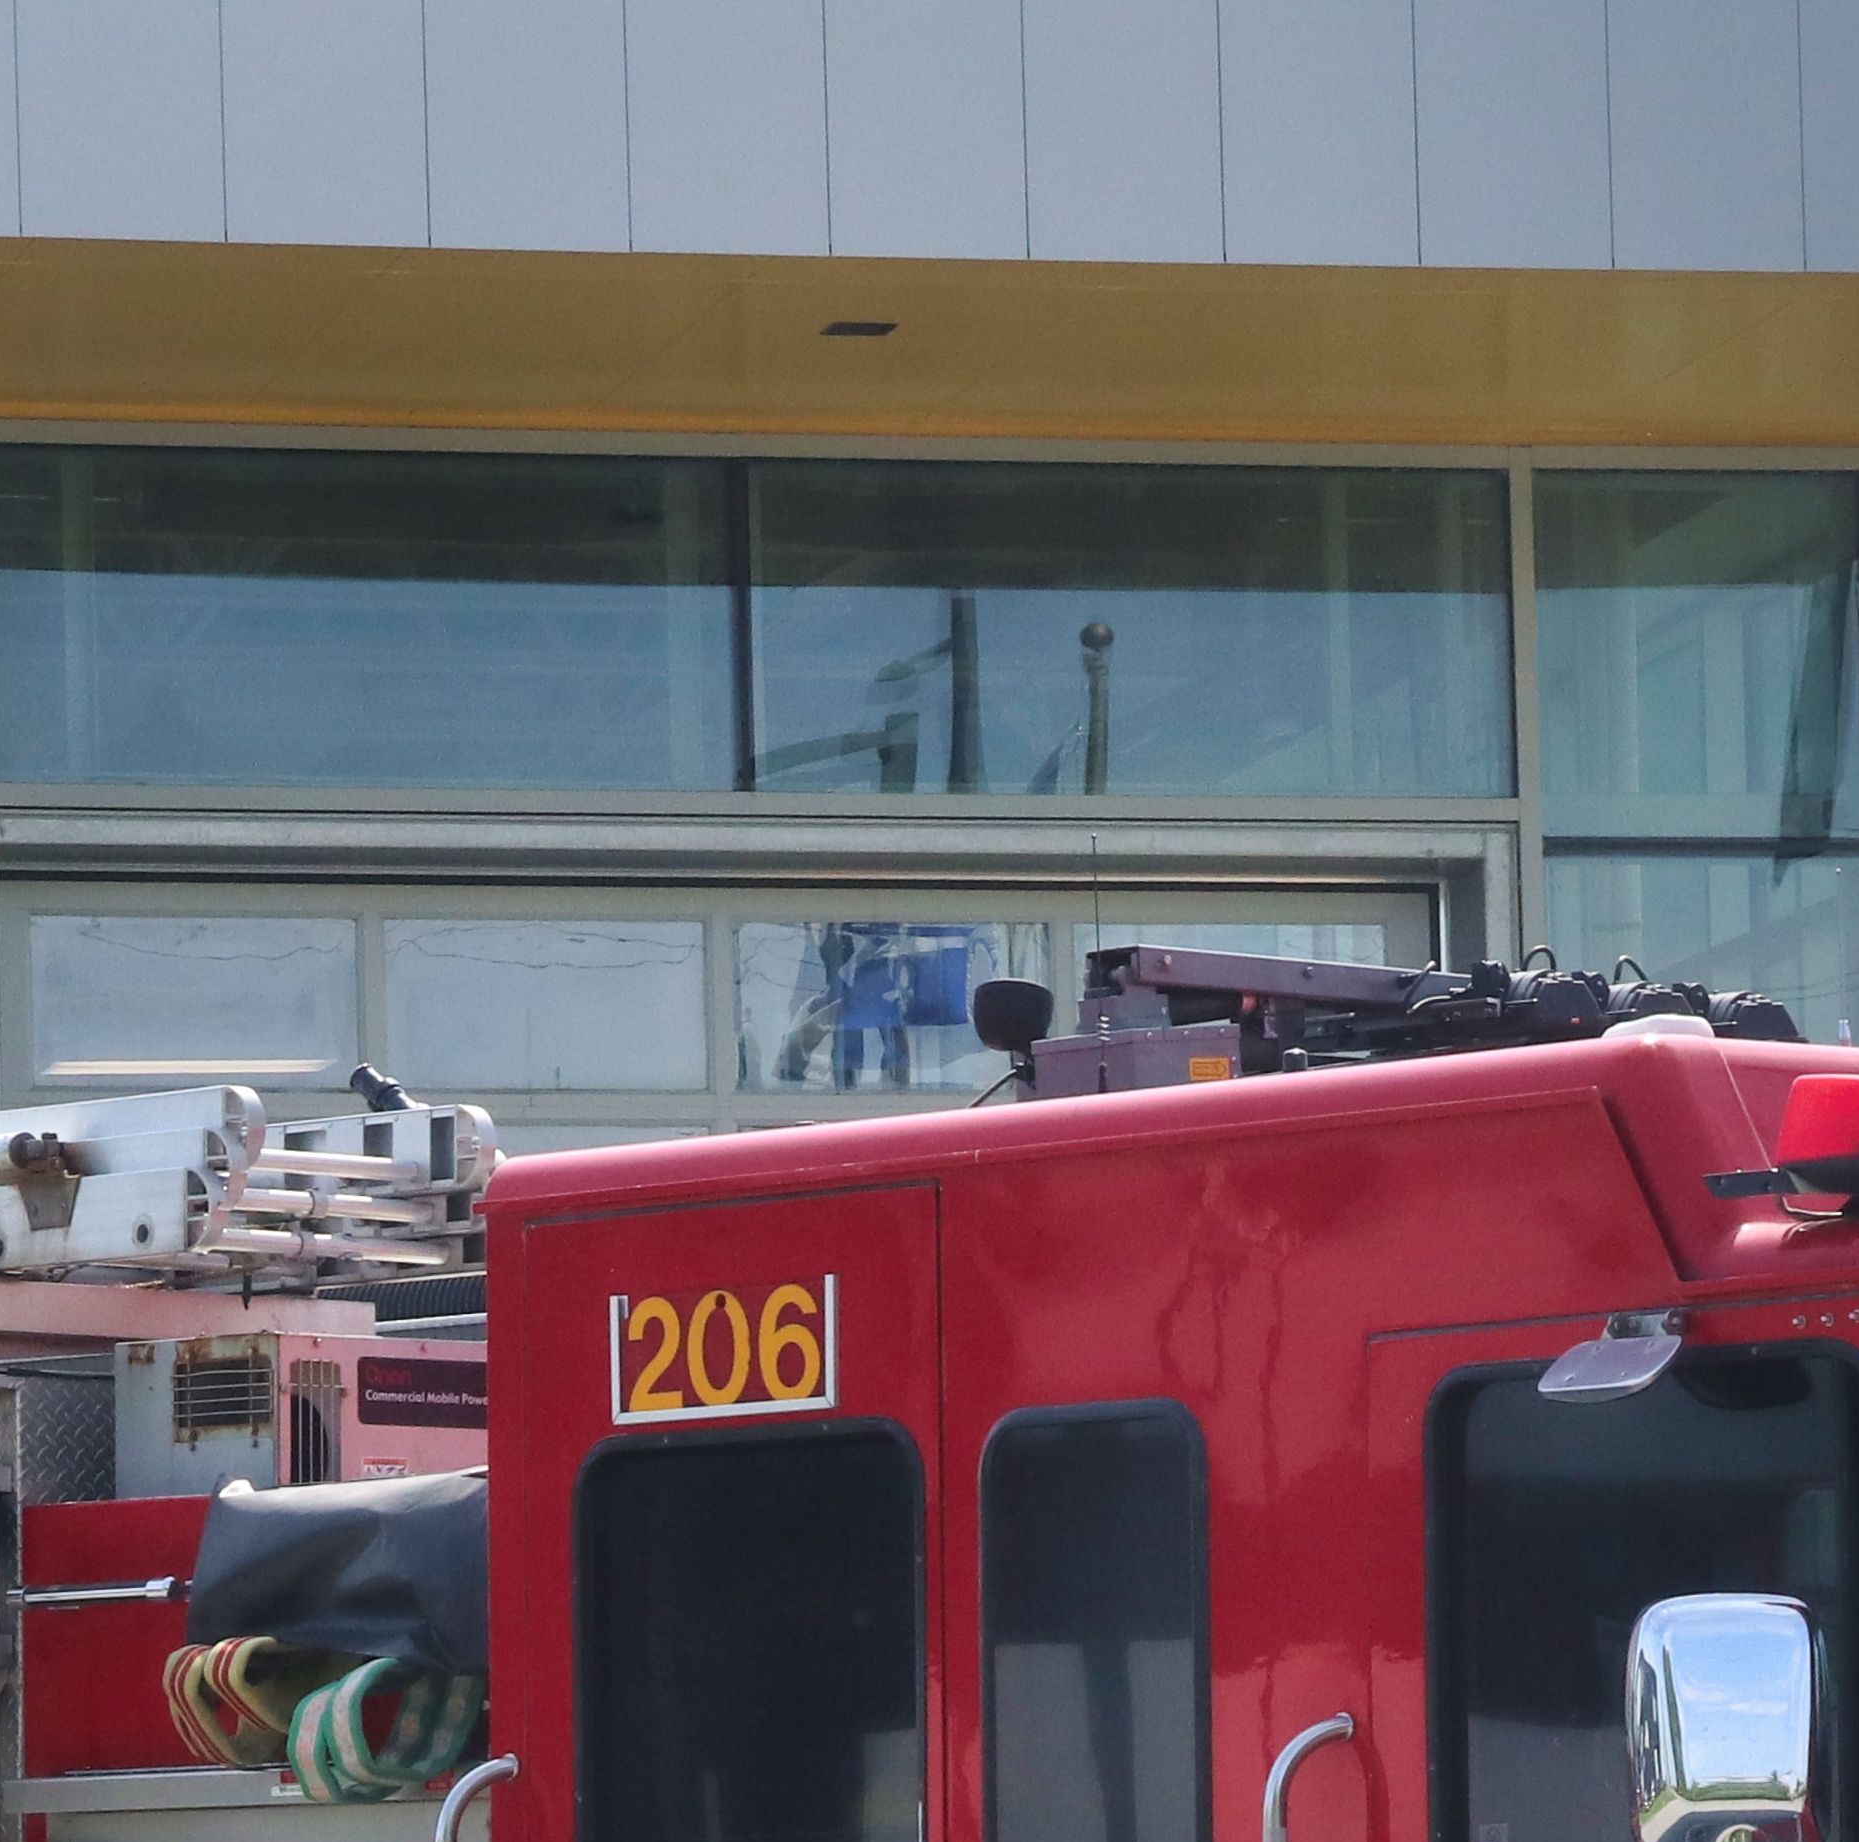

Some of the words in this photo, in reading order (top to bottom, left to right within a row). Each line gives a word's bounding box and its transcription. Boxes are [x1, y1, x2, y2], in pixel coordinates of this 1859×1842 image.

[628, 1284, 821, 1412] 206
[365, 1389, 425, 1403] Commercial
[427, 1392, 459, 1405] Mobile
